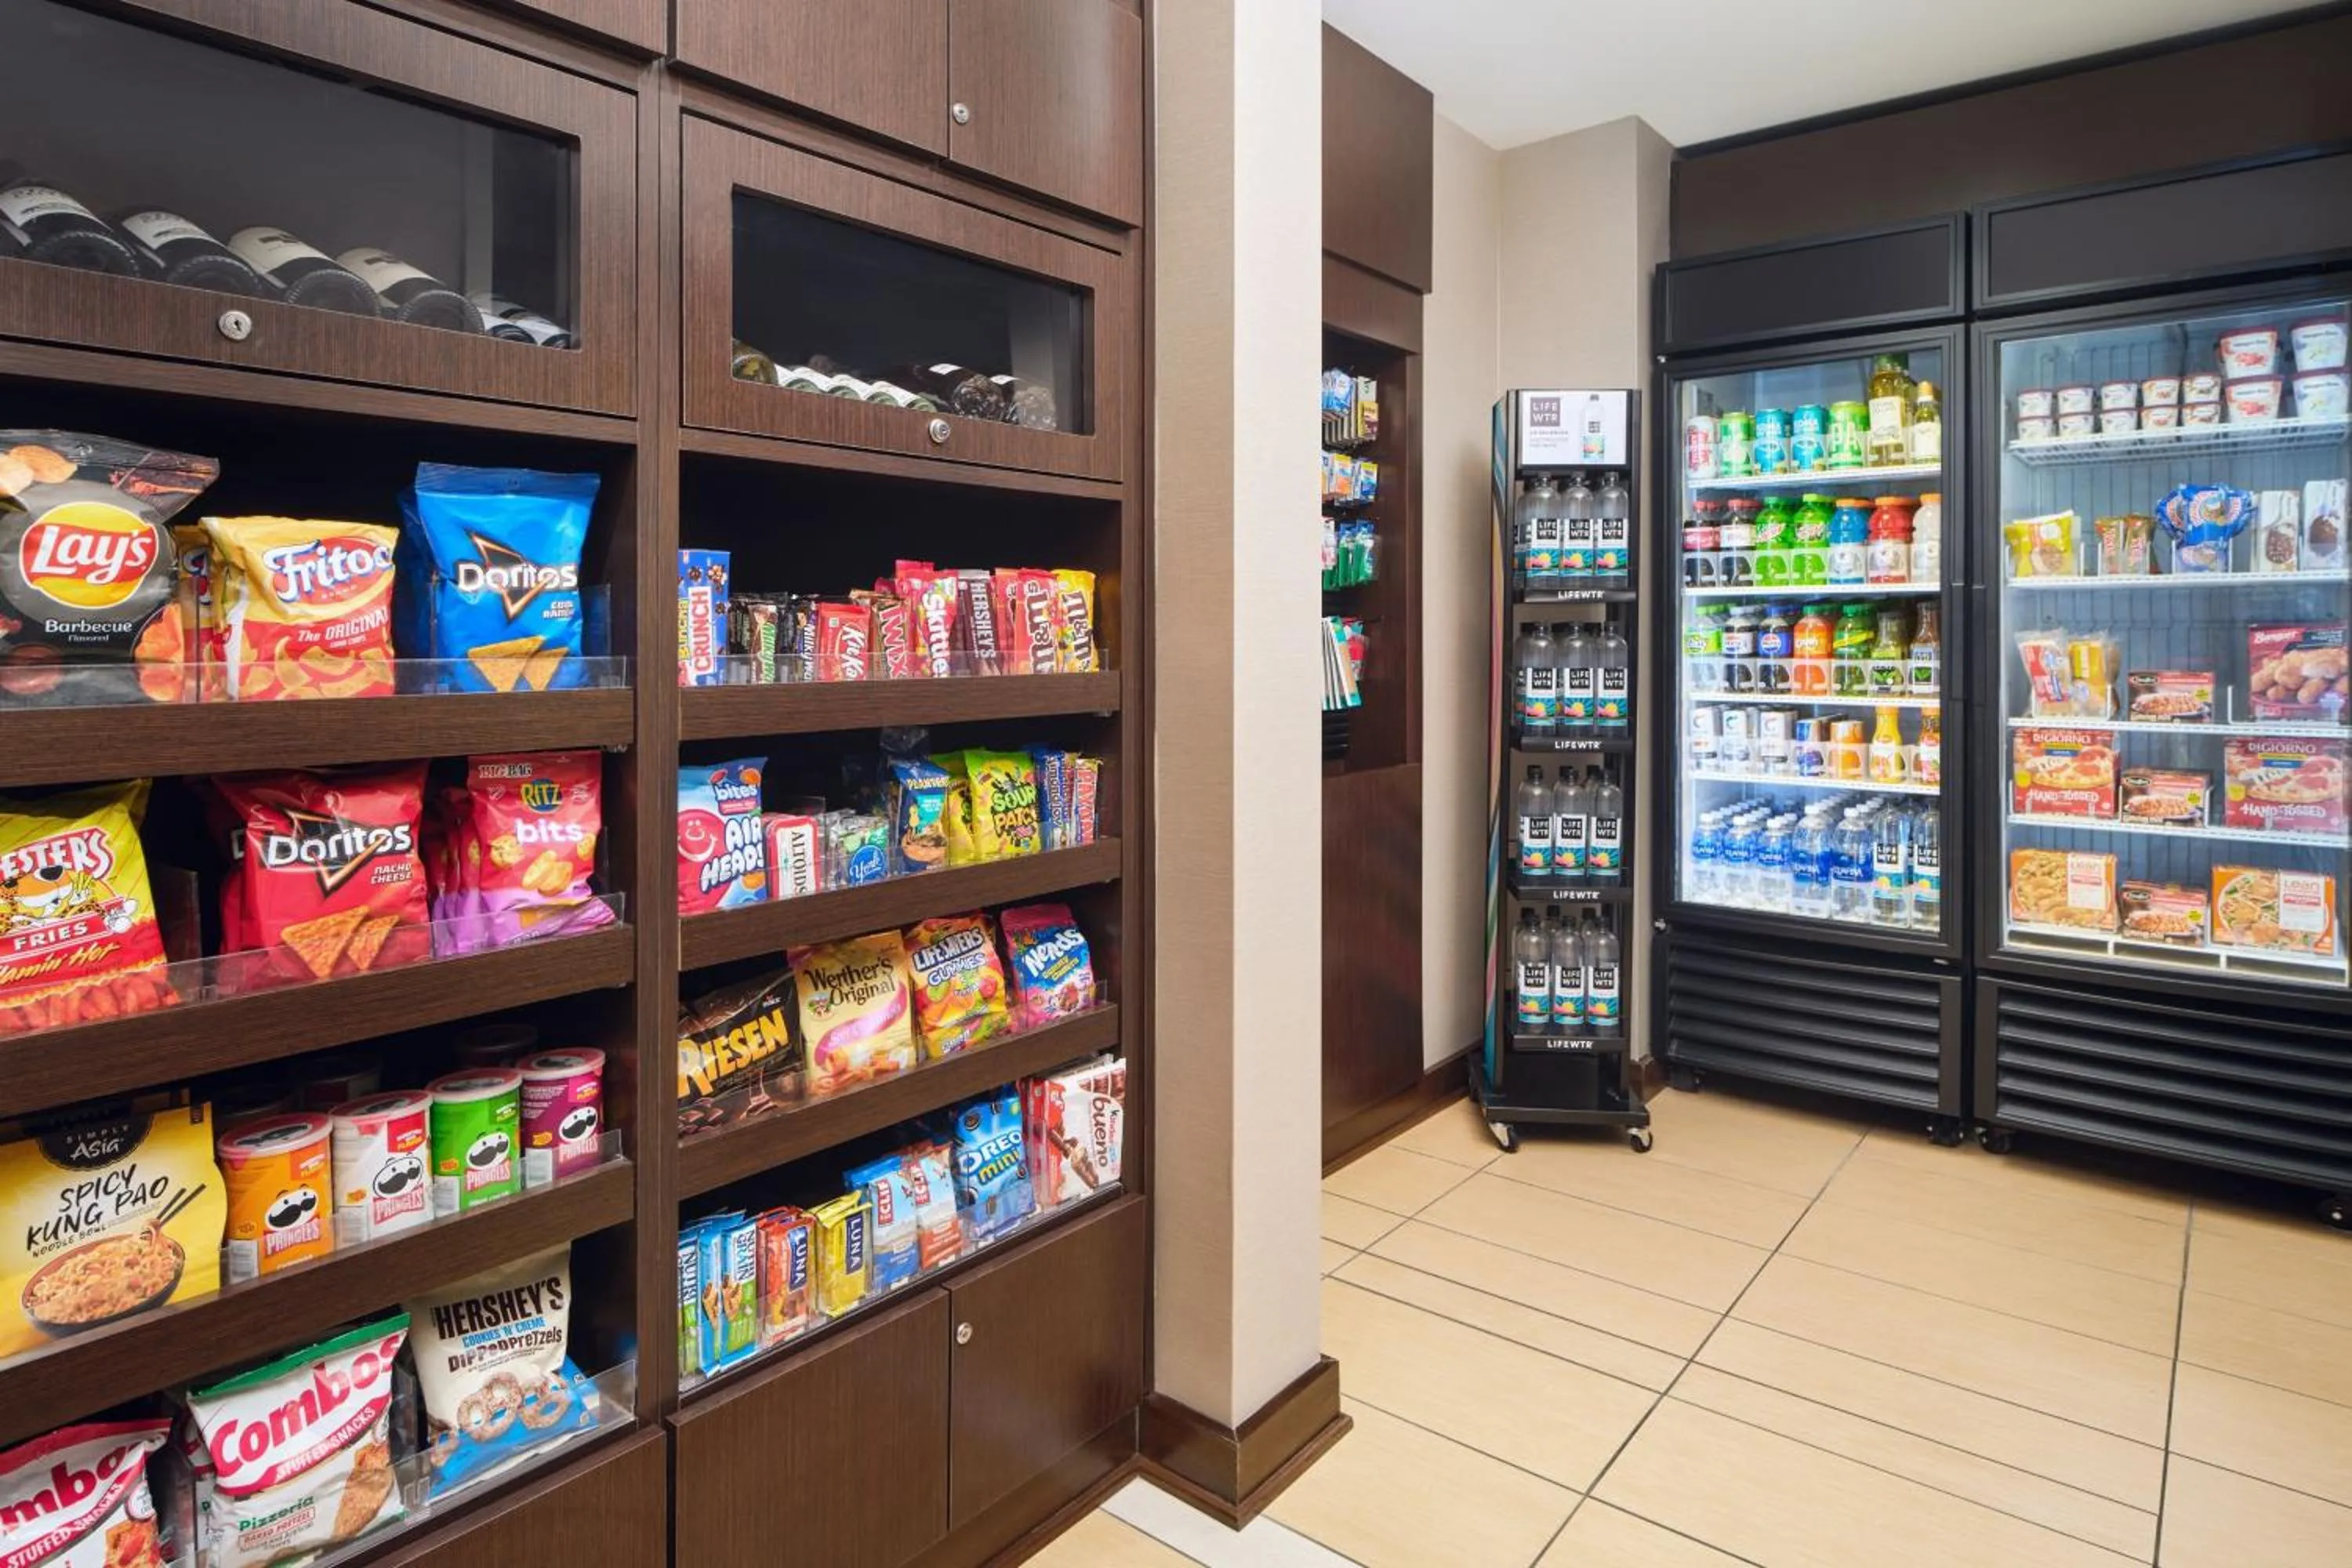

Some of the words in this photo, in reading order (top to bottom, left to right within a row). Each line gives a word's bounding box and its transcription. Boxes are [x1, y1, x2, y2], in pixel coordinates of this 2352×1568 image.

[1532, 401, 1558, 412] LIFE
[1532, 412, 1558, 423] WTR
[1538, 521, 1557, 529] LIFE
[1570, 521, 1589, 529] LIFE
[1602, 521, 1623, 529] LIFE
[31, 524, 154, 584] Lay's
[458, 561, 578, 592] Doritos
[1557, 590, 1605, 600] LIFEWTR
[44, 619, 132, 633] Barbecue
[297, 630, 321, 642] The
[325, 604, 389, 641] ORIGINA
[691, 590, 711, 672] CRUNCH
[969, 579, 996, 659] HERSHEY'S
[841, 624, 866, 681] KitKa
[802, 660, 815, 683] Wa
[1555, 741, 1602, 750] LIFEWTR
[521, 782, 564, 808] RITZ
[714, 785, 757, 801] bites
[992, 785, 1038, 812] SOUR
[265, 822, 413, 868] Doritos
[514, 817, 585, 844] bits
[2, 831, 112, 879] ESTER'S
[373, 862, 413, 875] NACHO
[792, 830, 808, 895] ALTOIDS
[370, 871, 414, 885] CHEESE
[1553, 890, 1600, 899] LIFEWTR
[13, 921, 89, 951] FRIES
[1024, 928, 1085, 978] Nerds
[68, 942, 121, 967] Hot
[928, 953, 986, 985] GUMMIES
[804, 956, 894, 993] Werther's
[829, 971, 896, 1006] Original
[677, 1008, 790, 1098] RIESEN
[1547, 1040, 1595, 1049] LIFEWTR
[67, 1124, 129, 1144] SIMPLY
[559, 1132, 599, 1163] PRINGLES
[1092, 1097, 1111, 1167] bueno
[70, 1138, 120, 1161] Asia
[958, 1130, 1024, 1174] OREO
[59, 1163, 136, 1213] SPICY
[466, 1158, 511, 1192] PRINGLES
[27, 1203, 103, 1251] KUNG
[115, 1176, 169, 1214] PAO
[375, 1185, 426, 1221] PRINGLES
[32, 1236, 75, 1258] NOODLE
[78, 1225, 107, 1241] BOWL
[266, 1217, 321, 1255] PRINGLES
[851, 1218, 862, 1269] LUNA
[795, 1232, 808, 1283] LUNA
[432, 1276, 564, 1340] HERSHEY'S
[462, 1327, 502, 1348] COOKIES
[517, 1317, 547, 1333] CREME
[209, 1332, 401, 1478] Combos
[274, 1443, 329, 1484] STUFFED
[328, 1406, 377, 1450] SNACKS
[0, 1441, 142, 1527] mbo
[7, 1526, 72, 1568] STUFFED
[73, 1483, 125, 1530] SNACKS
[238, 1495, 314, 1531] Pizzeria
